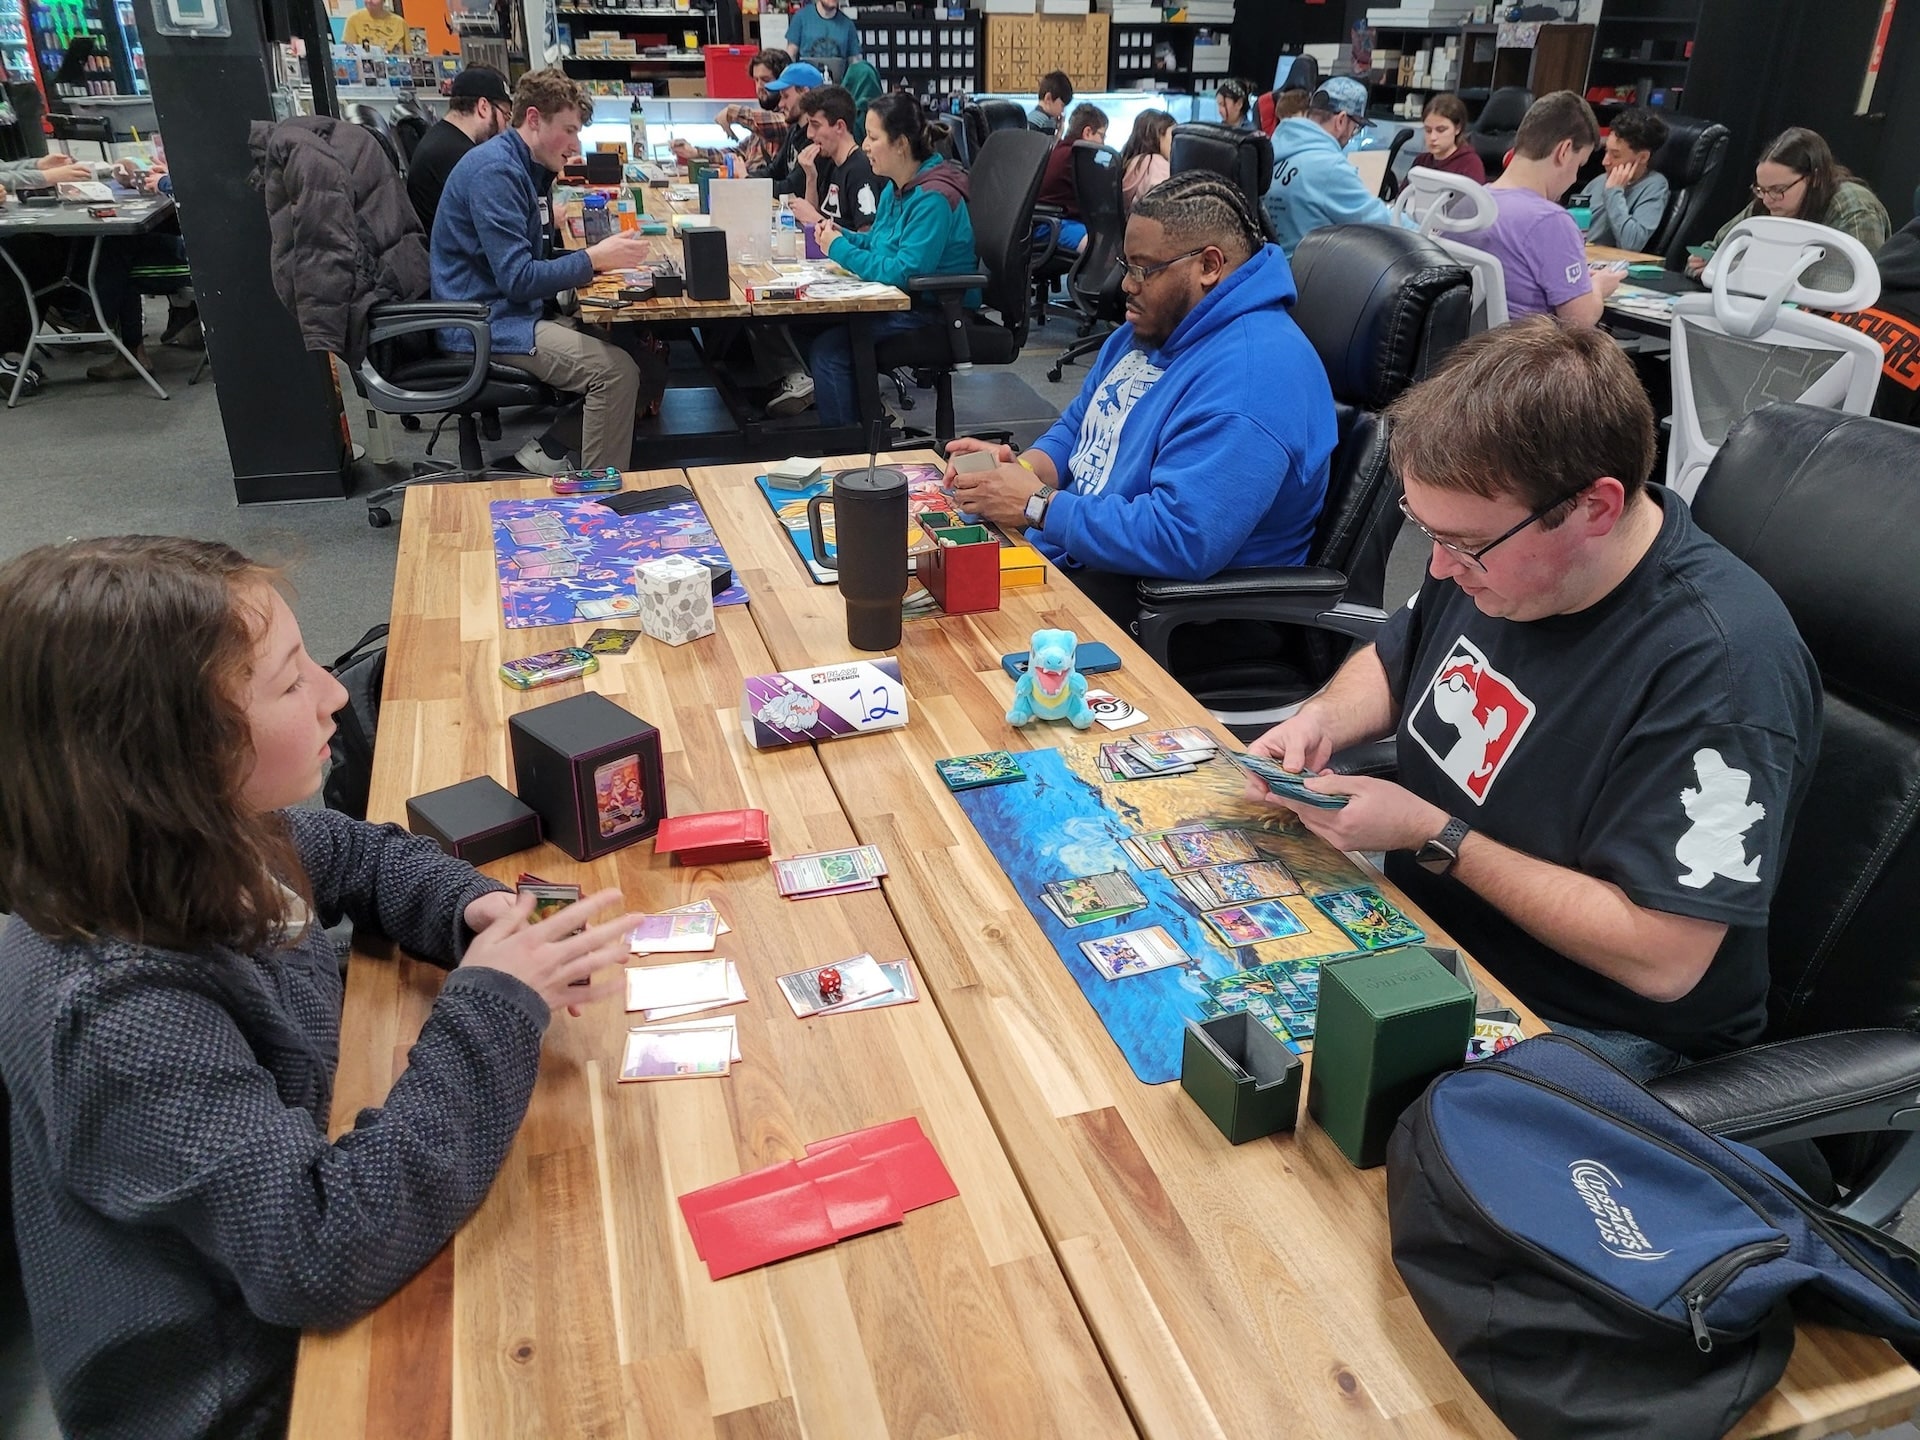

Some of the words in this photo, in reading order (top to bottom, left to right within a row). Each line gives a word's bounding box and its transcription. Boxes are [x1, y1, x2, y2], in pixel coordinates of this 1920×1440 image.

[849, 686, 899, 723] 12
[1595, 1218, 1620, 1245] US
[1597, 1194, 1642, 1251] STARTS
